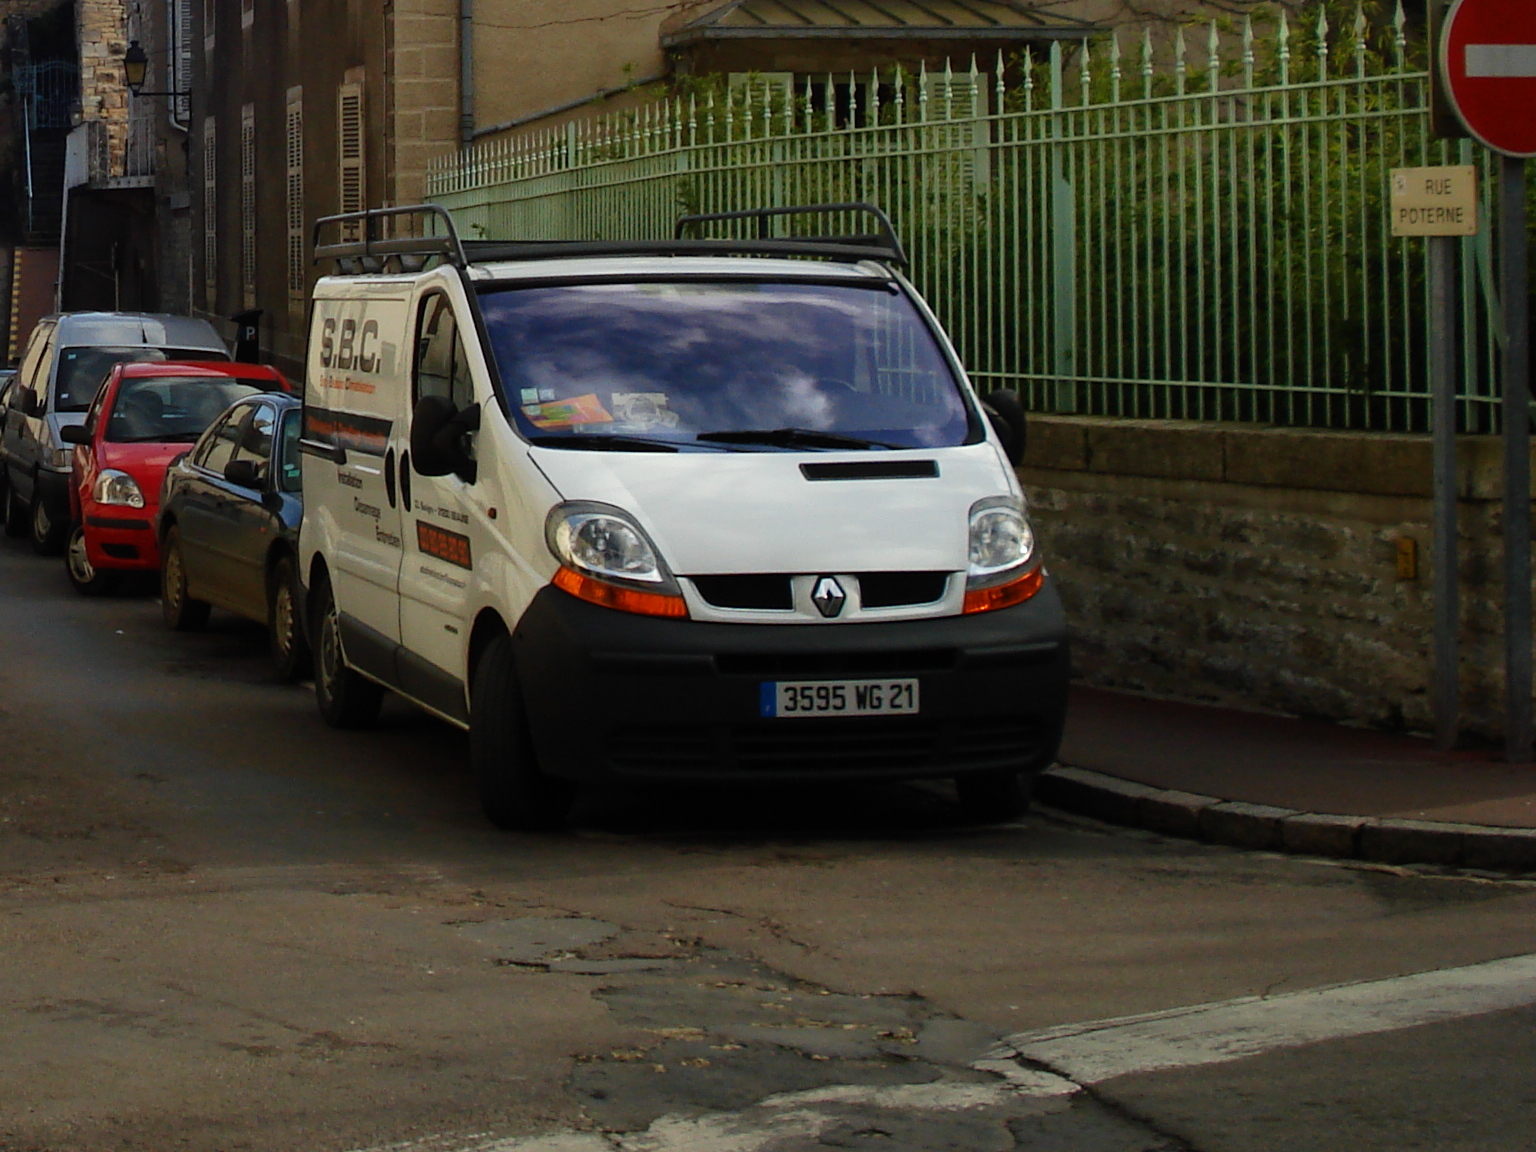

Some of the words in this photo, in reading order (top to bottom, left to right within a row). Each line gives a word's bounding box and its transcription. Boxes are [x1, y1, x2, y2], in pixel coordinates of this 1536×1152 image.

[1425, 179, 1452, 195] RUE
[1400, 208, 1464, 224] POTERNE
[246, 327, 255, 340] P
[320, 318, 381, 374] S.B.C.
[784, 686, 846, 711] 3595
[855, 684, 882, 710] WG
[890, 684, 913, 709] 21
